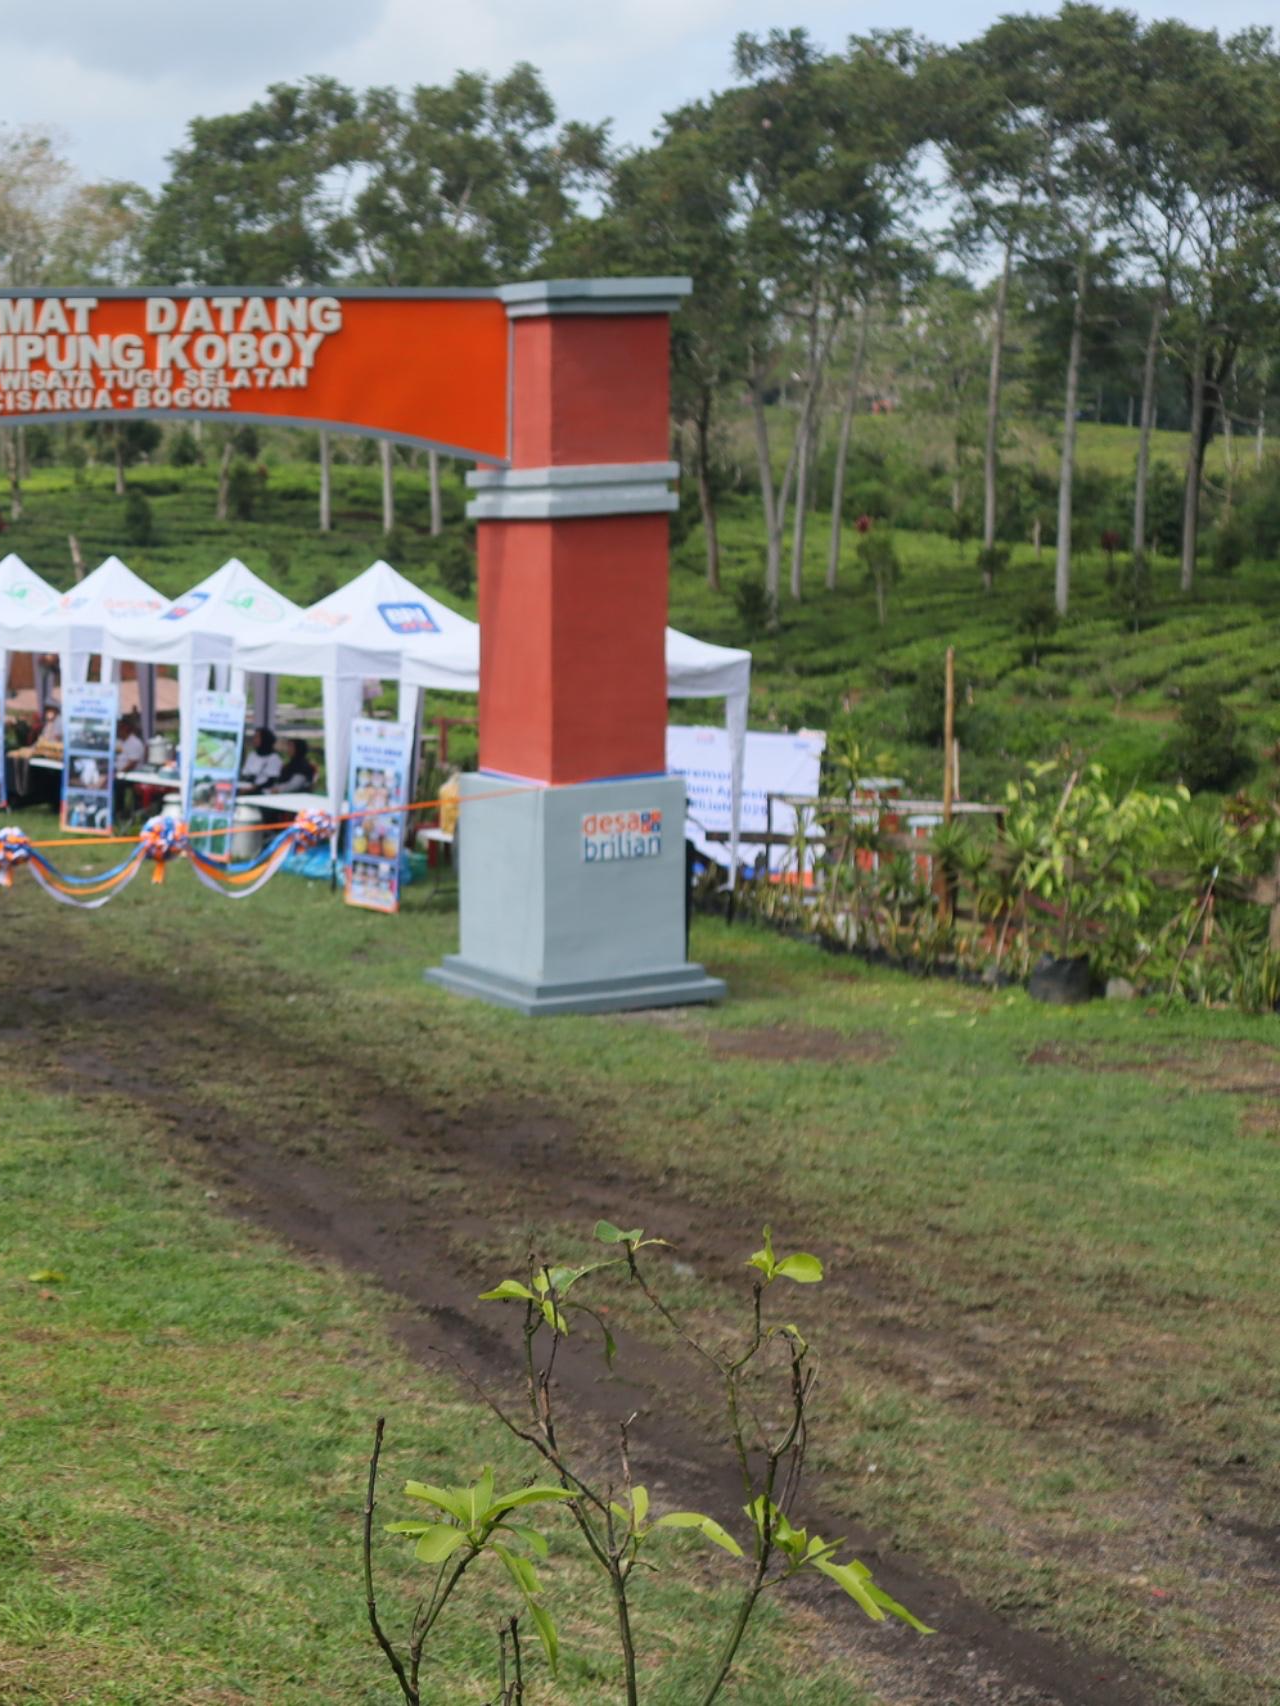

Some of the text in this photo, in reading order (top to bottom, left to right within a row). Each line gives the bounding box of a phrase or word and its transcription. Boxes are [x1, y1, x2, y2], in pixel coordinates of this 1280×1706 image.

[145, 297, 343, 335] DATANG
[156, 332, 324, 370] KOBOY
[99, 369, 173, 390] TUGU
[183, 367, 308, 389] SELATAN
[133, 387, 231, 409] BOGOR
[582, 812, 640, 837] desa
[584, 835, 662, 863] brilian
